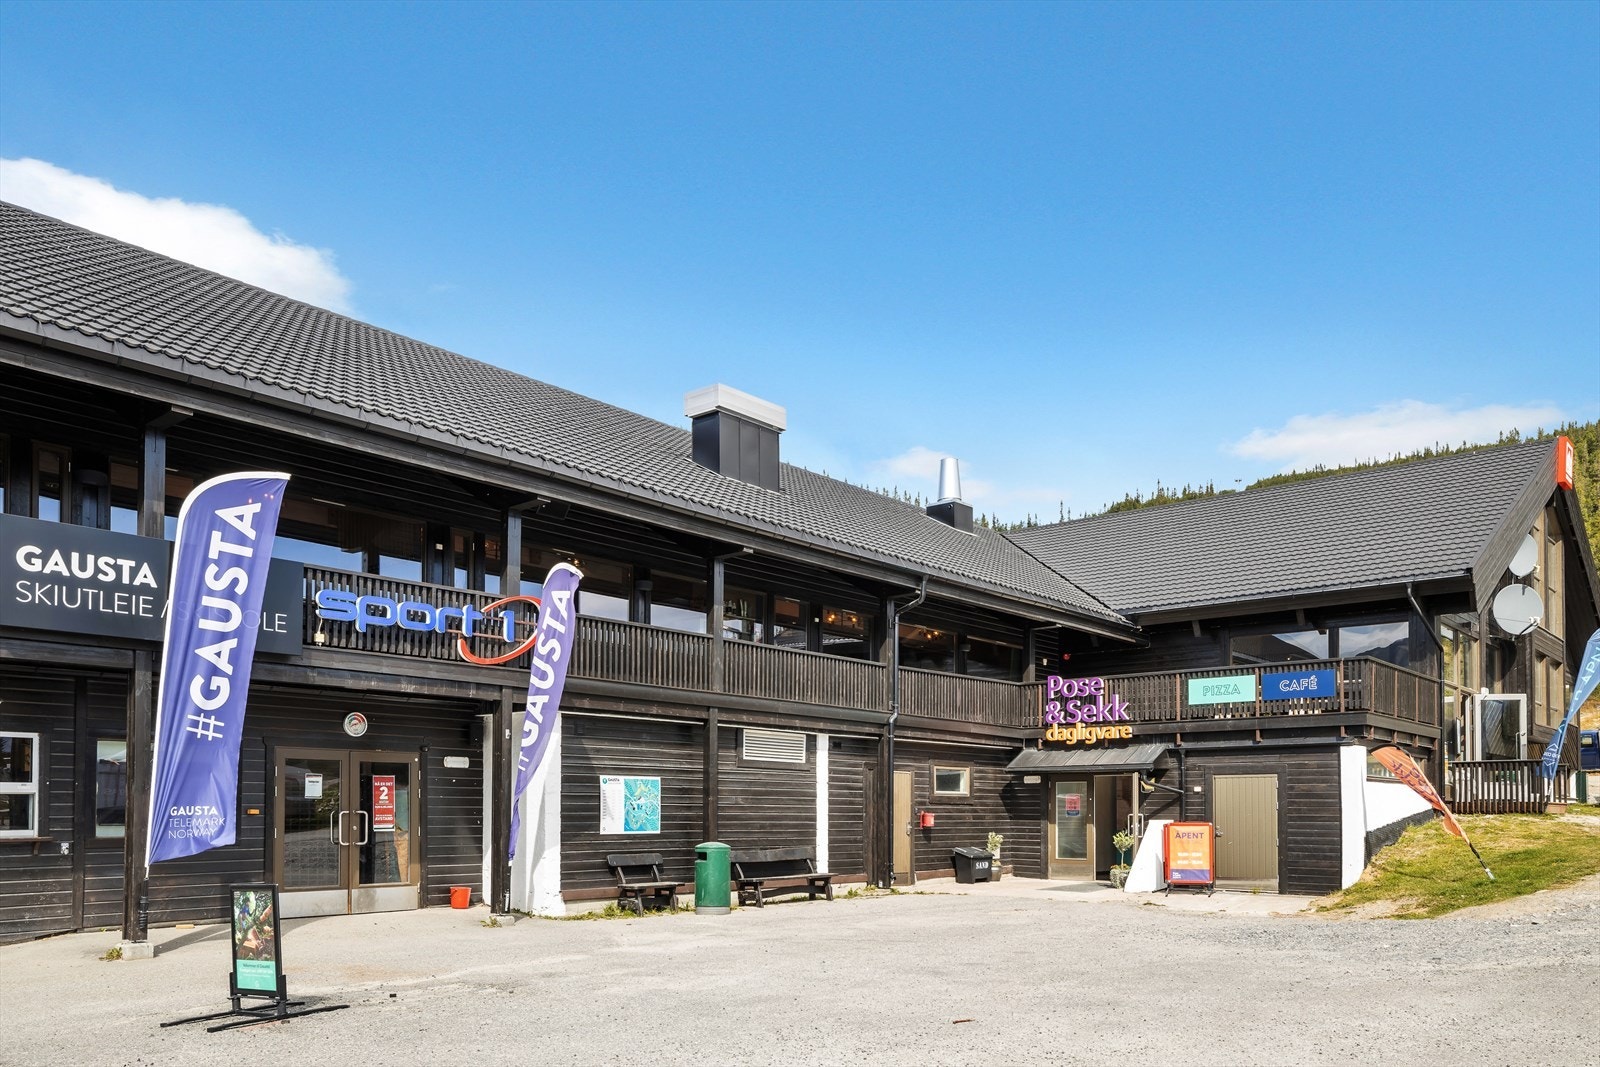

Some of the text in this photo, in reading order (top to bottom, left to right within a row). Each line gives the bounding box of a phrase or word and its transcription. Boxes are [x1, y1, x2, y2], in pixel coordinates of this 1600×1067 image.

[15, 545, 158, 588] GAUSTA
[15, 580, 154, 618] SKIUTLEIE
[186, 502, 262, 742] #GAUSTA
[316, 589, 515, 643] sport 1
[1047, 675, 1105, 699] Pose
[1202, 684, 1241, 697] PIZZA
[1279, 675, 1318, 692] CAFÉ
[1046, 723, 1133, 745] dagligvare
[379, 786, 389, 800] 2
[170, 805, 219, 817] GAUSTA
[169, 817, 226, 829] TELEMARK
[168, 827, 217, 840] NORWAY
